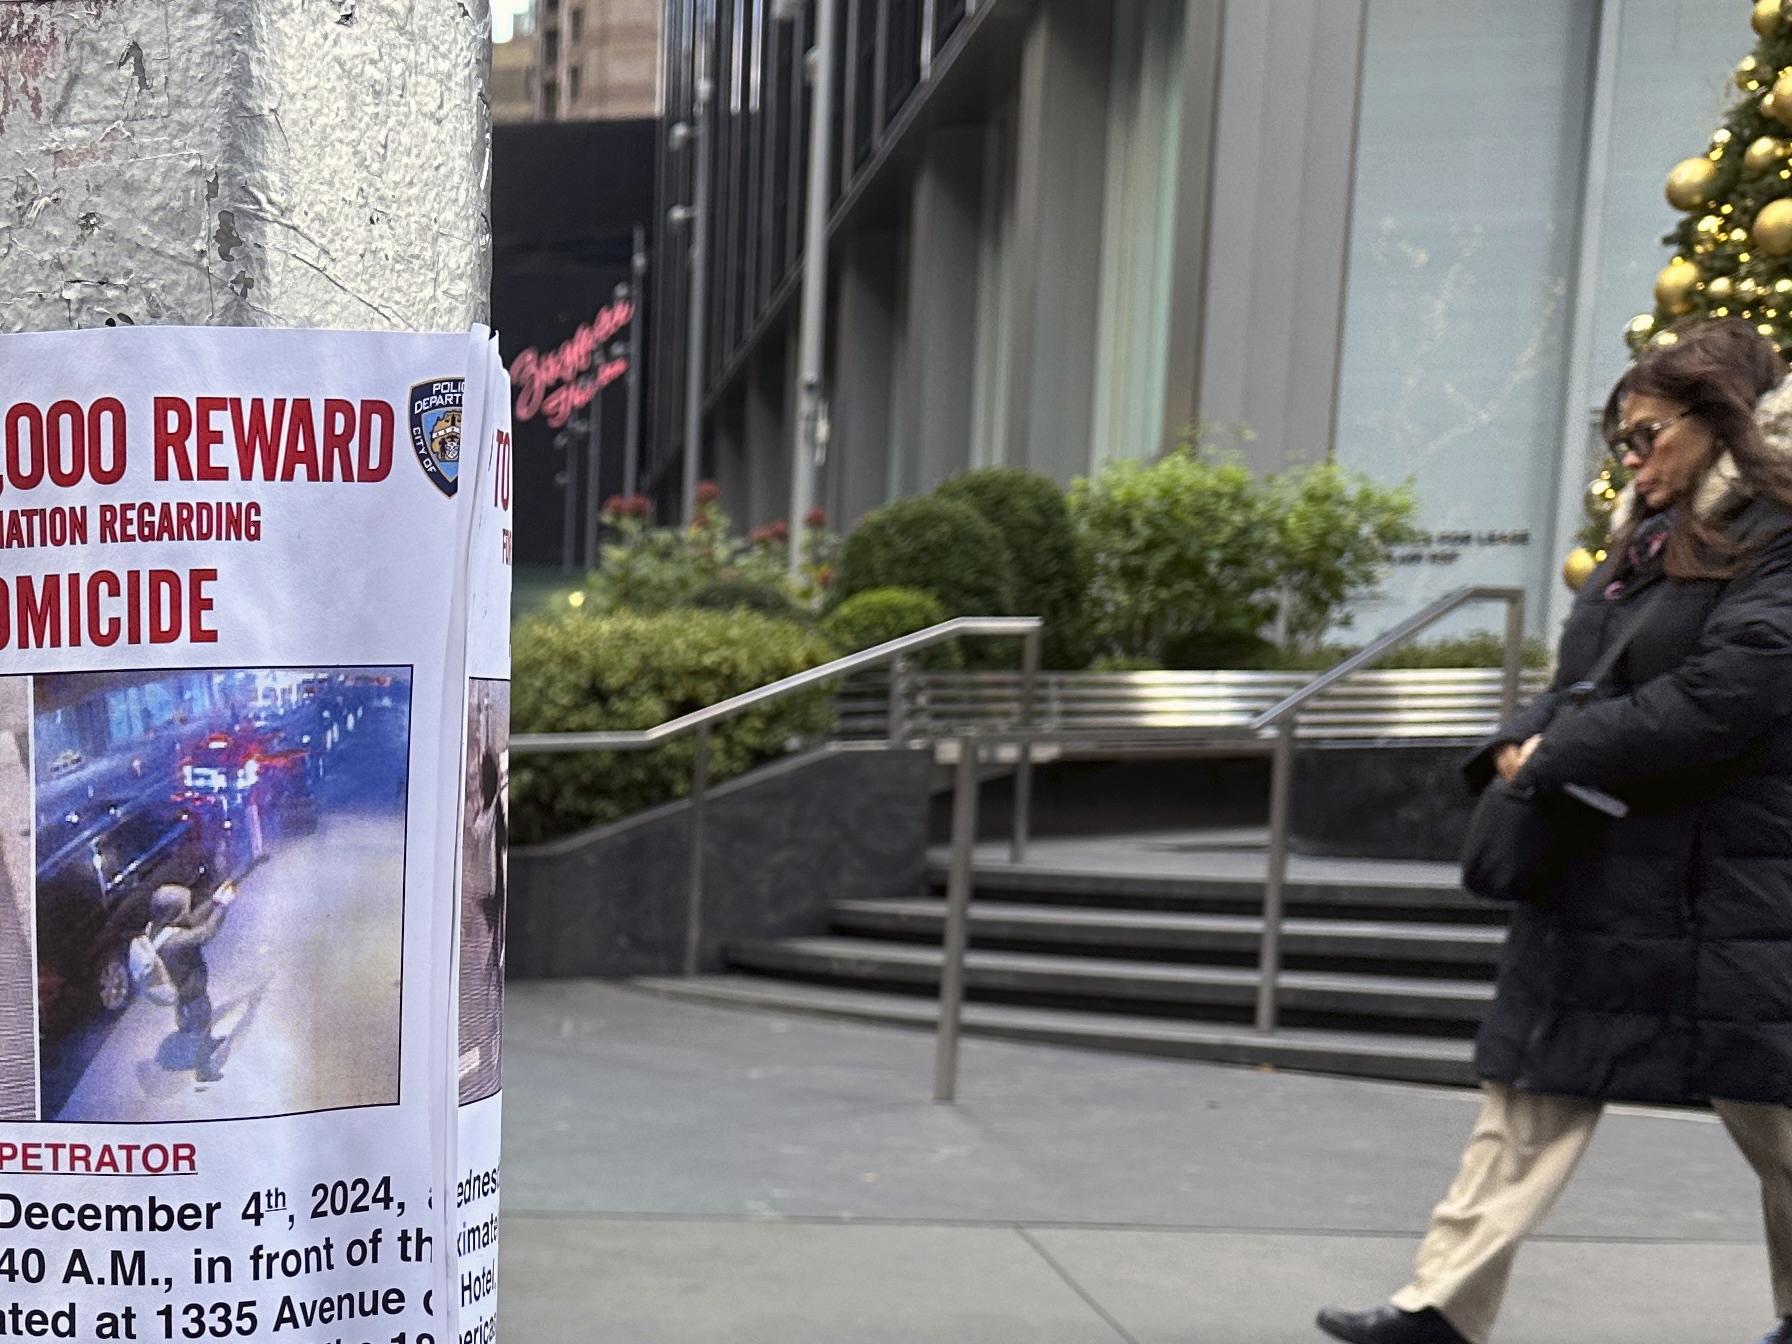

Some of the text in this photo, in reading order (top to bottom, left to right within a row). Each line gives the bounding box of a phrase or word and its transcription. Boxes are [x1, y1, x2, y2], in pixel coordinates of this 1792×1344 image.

[153, 397, 394, 484] REWARD
[412, 427, 437, 473] CITY OF
[100, 502, 262, 544] REGARDING
[310, 1175, 405, 1218] 2024,
[62, 1249, 173, 1292] A.M.,
[194, 1248, 232, 1284] in
[250, 1236, 334, 1281] front
[346, 1228, 383, 1267] of
[397, 1227, 433, 1263] th
[96, 1303, 136, 1339] at
[157, 1300, 258, 1339] 1335
[273, 1286, 405, 1332] Avenue
